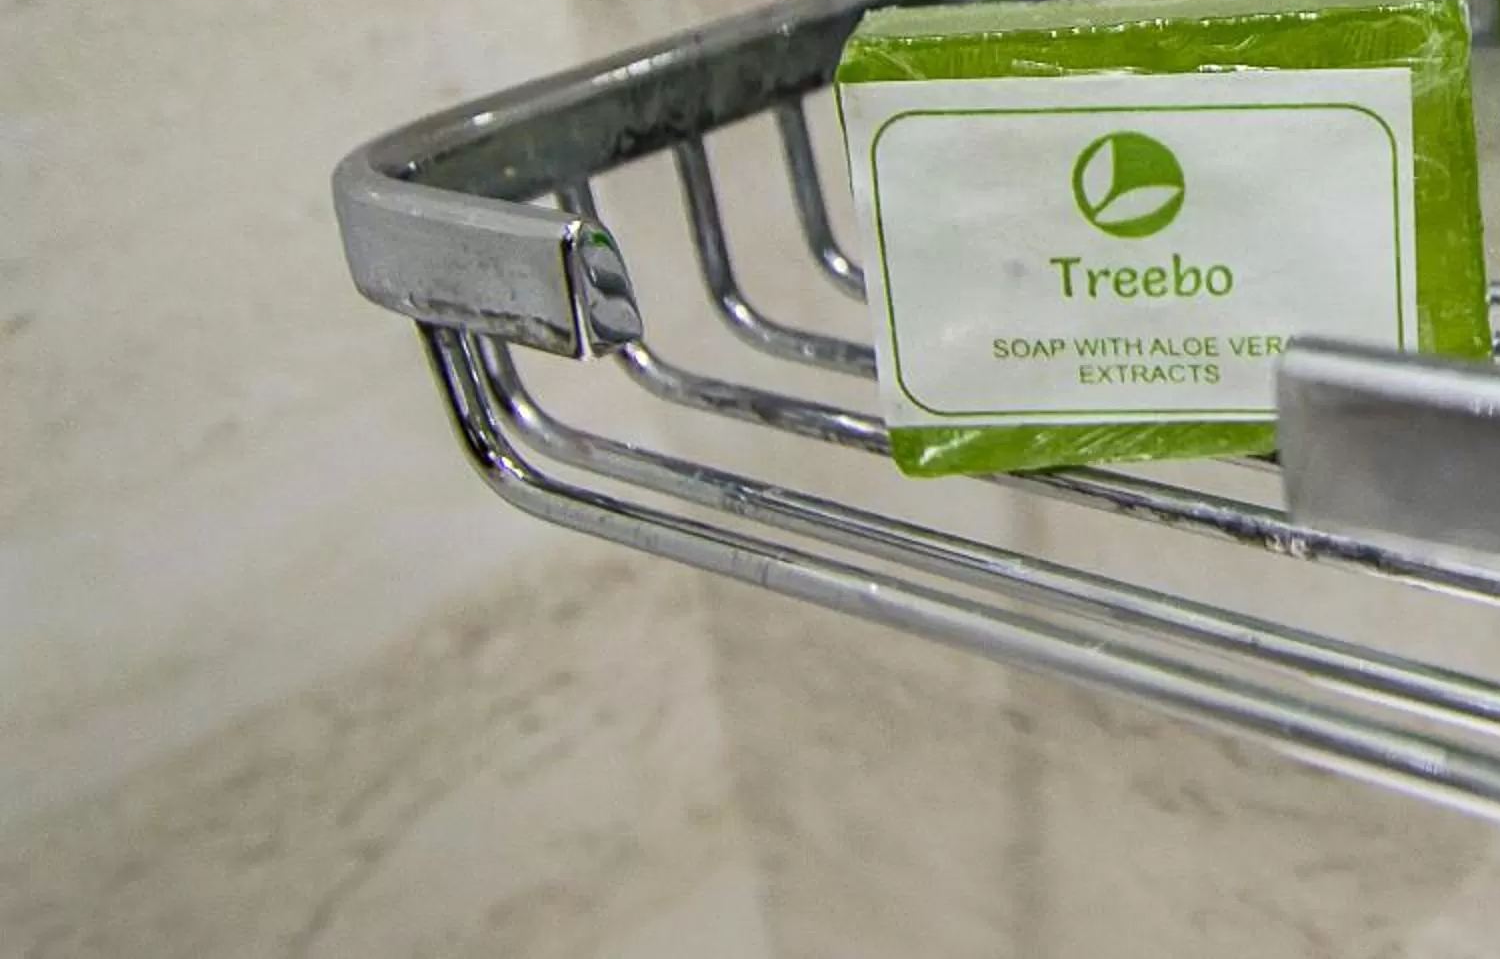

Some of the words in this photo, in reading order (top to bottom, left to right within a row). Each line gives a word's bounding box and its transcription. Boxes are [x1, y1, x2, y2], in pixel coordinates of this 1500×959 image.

[1050, 253, 1234, 298] Treebo
[992, 338, 1066, 359] SOAP
[1074, 337, 1143, 358] WITH
[1149, 336, 1221, 357] ALOE
[1078, 364, 1222, 385] EXTRACTS
